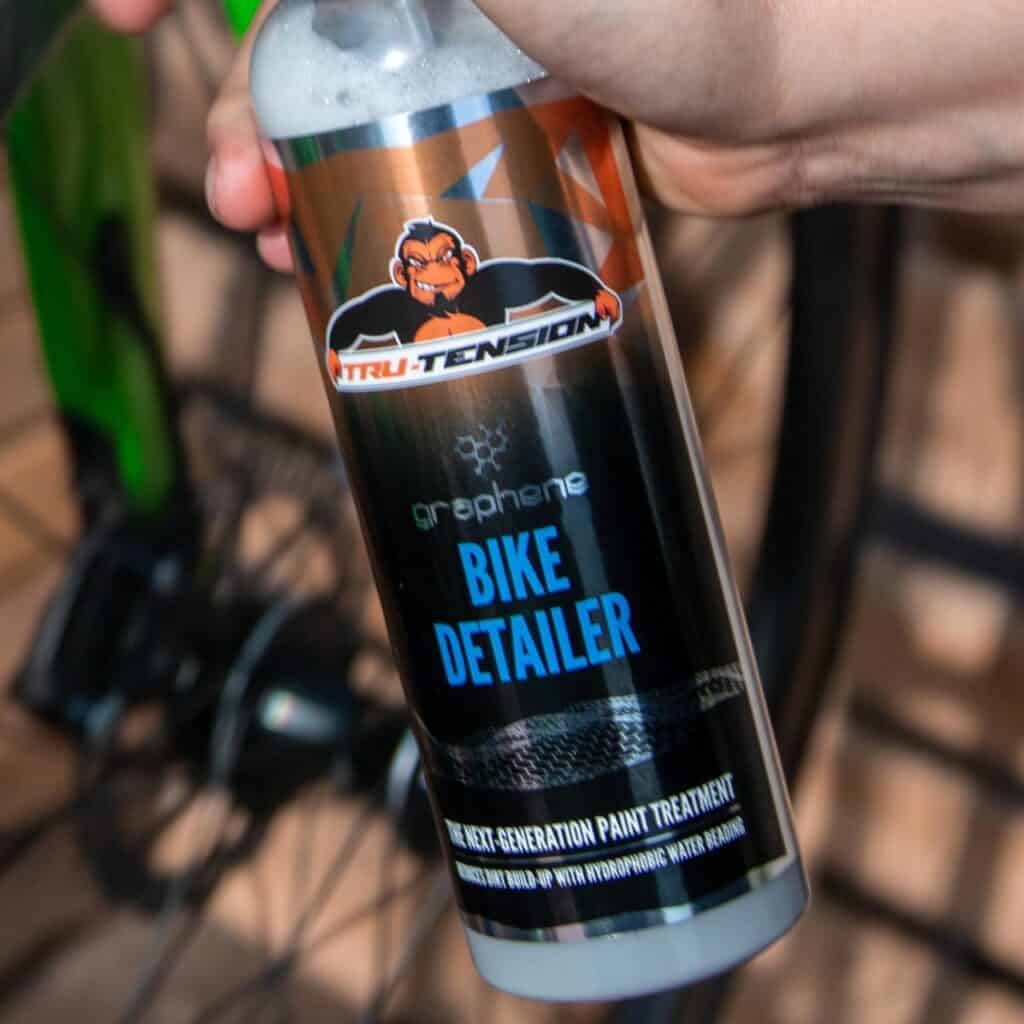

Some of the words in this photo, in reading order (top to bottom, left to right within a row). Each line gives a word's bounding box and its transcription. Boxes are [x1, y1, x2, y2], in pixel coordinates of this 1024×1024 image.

[342, 312, 604, 382] TRU-TENSION
[412, 472, 589, 531] graphene
[457, 525, 572, 608] BIKE
[433, 591, 641, 688] DETAILER
[463, 818, 597, 854] NEXT-GENERATION
[594, 806, 649, 843] PAINT
[648, 772, 736, 829] TREATMENT
[505, 868, 554, 890] BUILD-UP
[553, 863, 586, 888] WITH
[584, 848, 668, 884] HYDROPHOBIC
[665, 834, 707, 865] WATER
[703, 816, 746, 850] BEADING
